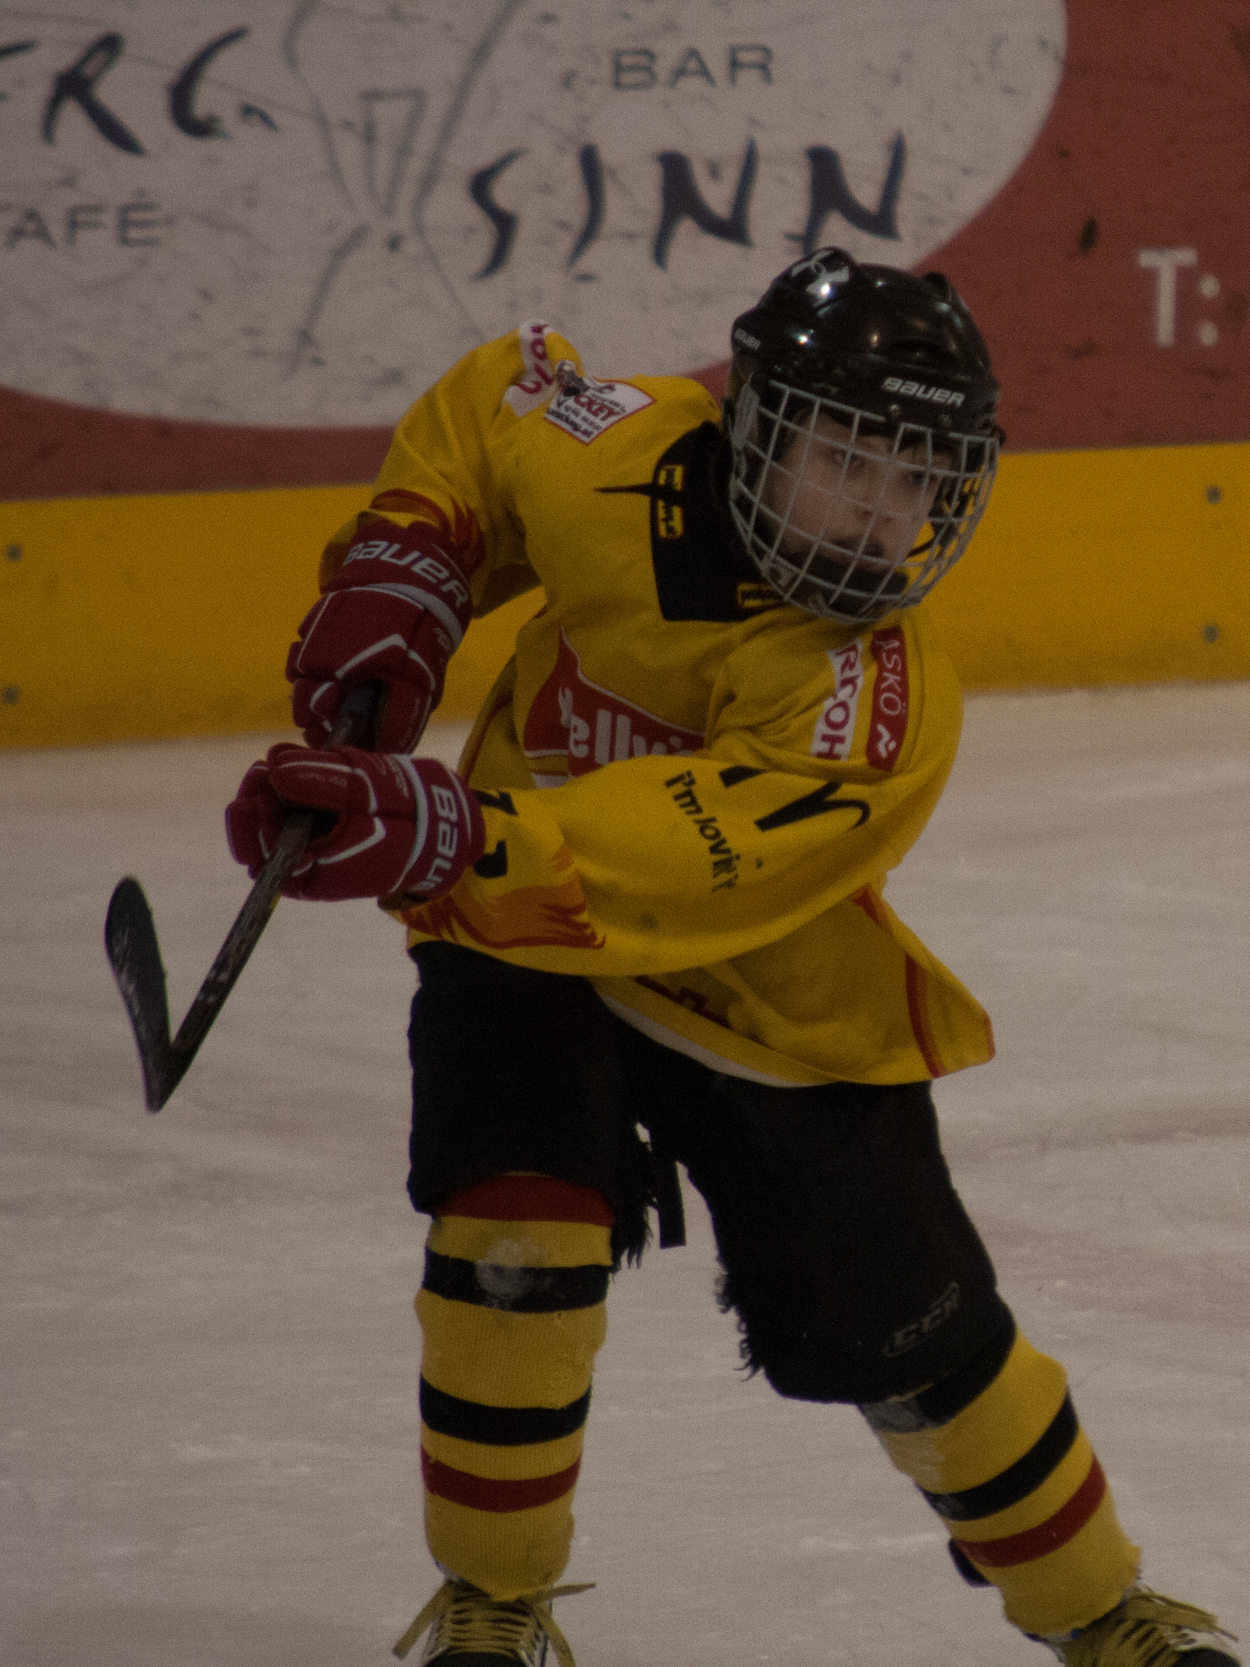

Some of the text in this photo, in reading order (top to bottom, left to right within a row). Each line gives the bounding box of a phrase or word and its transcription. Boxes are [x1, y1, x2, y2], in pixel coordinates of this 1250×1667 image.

[611, 43, 773, 91] BAR
[470, 130, 906, 280] SINN
[1136, 245, 1220, 348] T:
[880, 376, 966, 408] BAUER
[875, 638, 907, 717] ASKÖ
